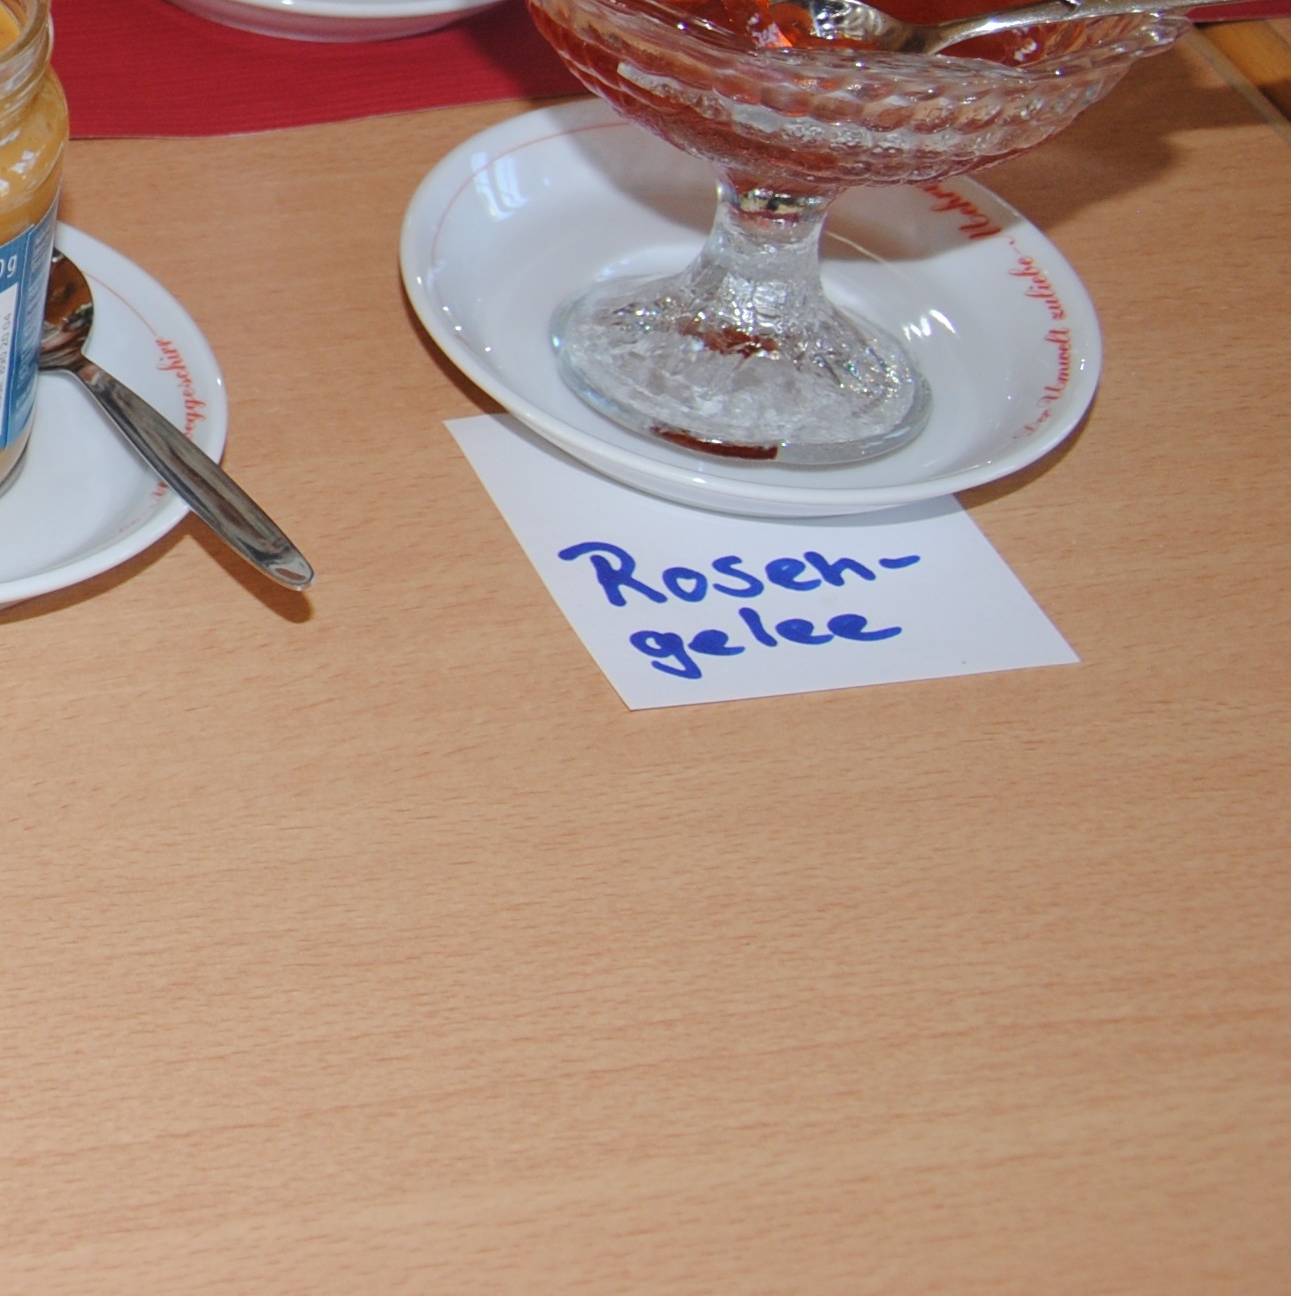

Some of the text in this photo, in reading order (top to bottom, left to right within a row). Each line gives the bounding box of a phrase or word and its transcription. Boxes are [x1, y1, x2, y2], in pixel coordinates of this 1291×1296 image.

[6, 254, 19, 278] g
[557, 539, 923, 608] Rosen-
[629, 606, 903, 680] gelee
